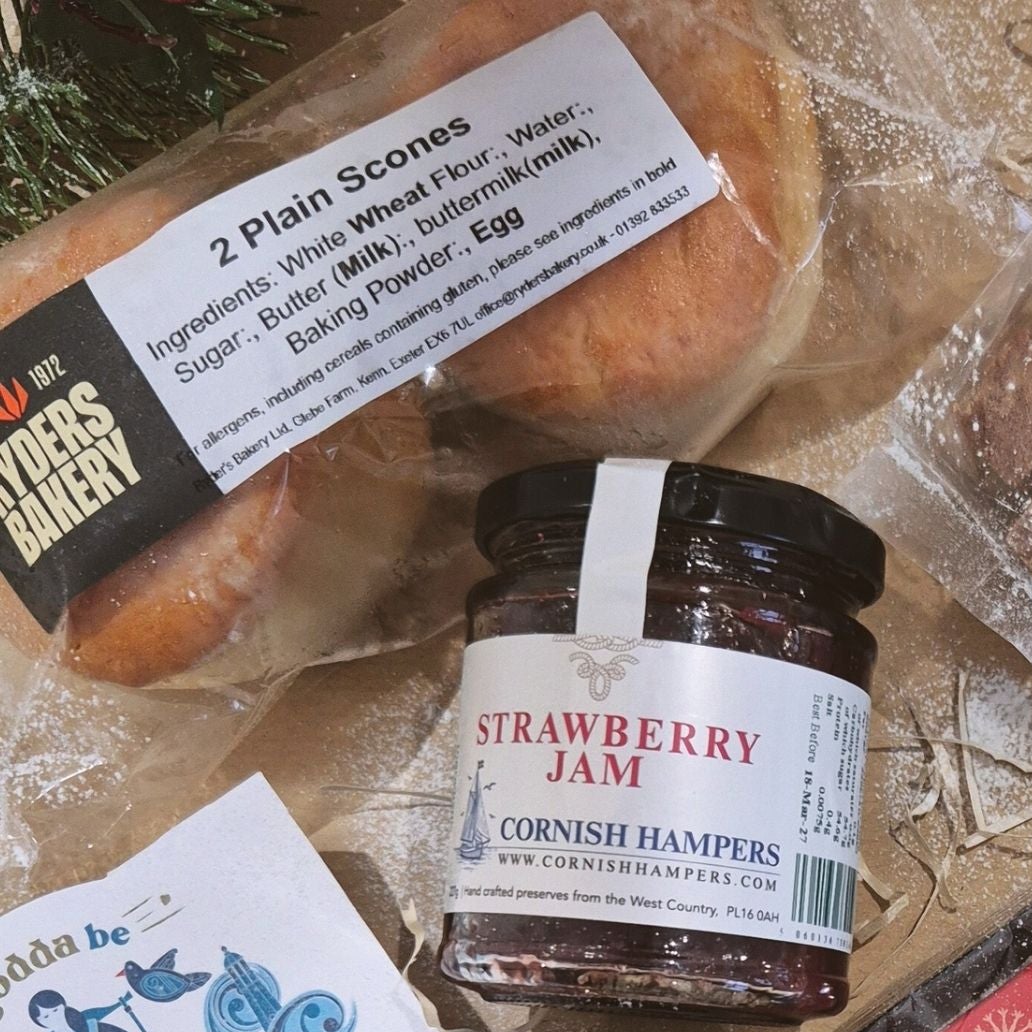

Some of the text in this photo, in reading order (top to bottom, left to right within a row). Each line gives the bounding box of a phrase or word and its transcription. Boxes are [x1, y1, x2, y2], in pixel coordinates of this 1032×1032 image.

[209, 116, 472, 268] 2 Plain Scones
[146, 271, 279, 362] Ingredients:
[276, 230, 347, 277] White
[346, 181, 430, 235] Wheat
[285, 296, 369, 356] Baking
[468, 206, 525, 245] Egg
[203, 405, 266, 451] allergens,
[264, 367, 325, 409] including
[324, 337, 373, 374] cereals
[374, 297, 443, 345] containing
[442, 273, 489, 302] gluten,
[488, 244, 534, 278] please
[533, 229, 560, 250] see
[558, 187, 631, 235] ingredients
[632, 178, 647, 192] in
[648, 157, 678, 184] bold
[231, 434, 271, 465] Bakery
[292, 404, 325, 427] Glebe
[391, 344, 425, 371] Exeter
[424, 329, 450, 350] EX6
[450, 316, 475, 335] 7UL
[615, 210, 650, 237] 01392
[649, 185, 691, 217] 833533
[256, 278, 329, 332] Butter
[27, 354, 67, 391] 1972
[3, 426, 142, 568] BAKERY
[826, 693, 834, 717] Salt
[833, 696, 843, 741] Protein
[476, 711, 761, 765] STRAWBERRY
[546, 750, 644, 788] JAM
[799, 693, 823, 844] Best Before 18-Mar-27
[500, 816, 781, 867] CORNISH HAMPERS
[498, 852, 777, 892] WWW.CORNISHHAMPERS.COM
[483, 884, 514, 898] crafted
[516, 887, 569, 901] preserves
[573, 888, 601, 904] from
[605, 891, 626, 906] the
[629, 894, 662, 910] West
[666, 898, 719, 918] Country,
[726, 905, 754, 920] PL16
[84, 922, 131, 950] be
